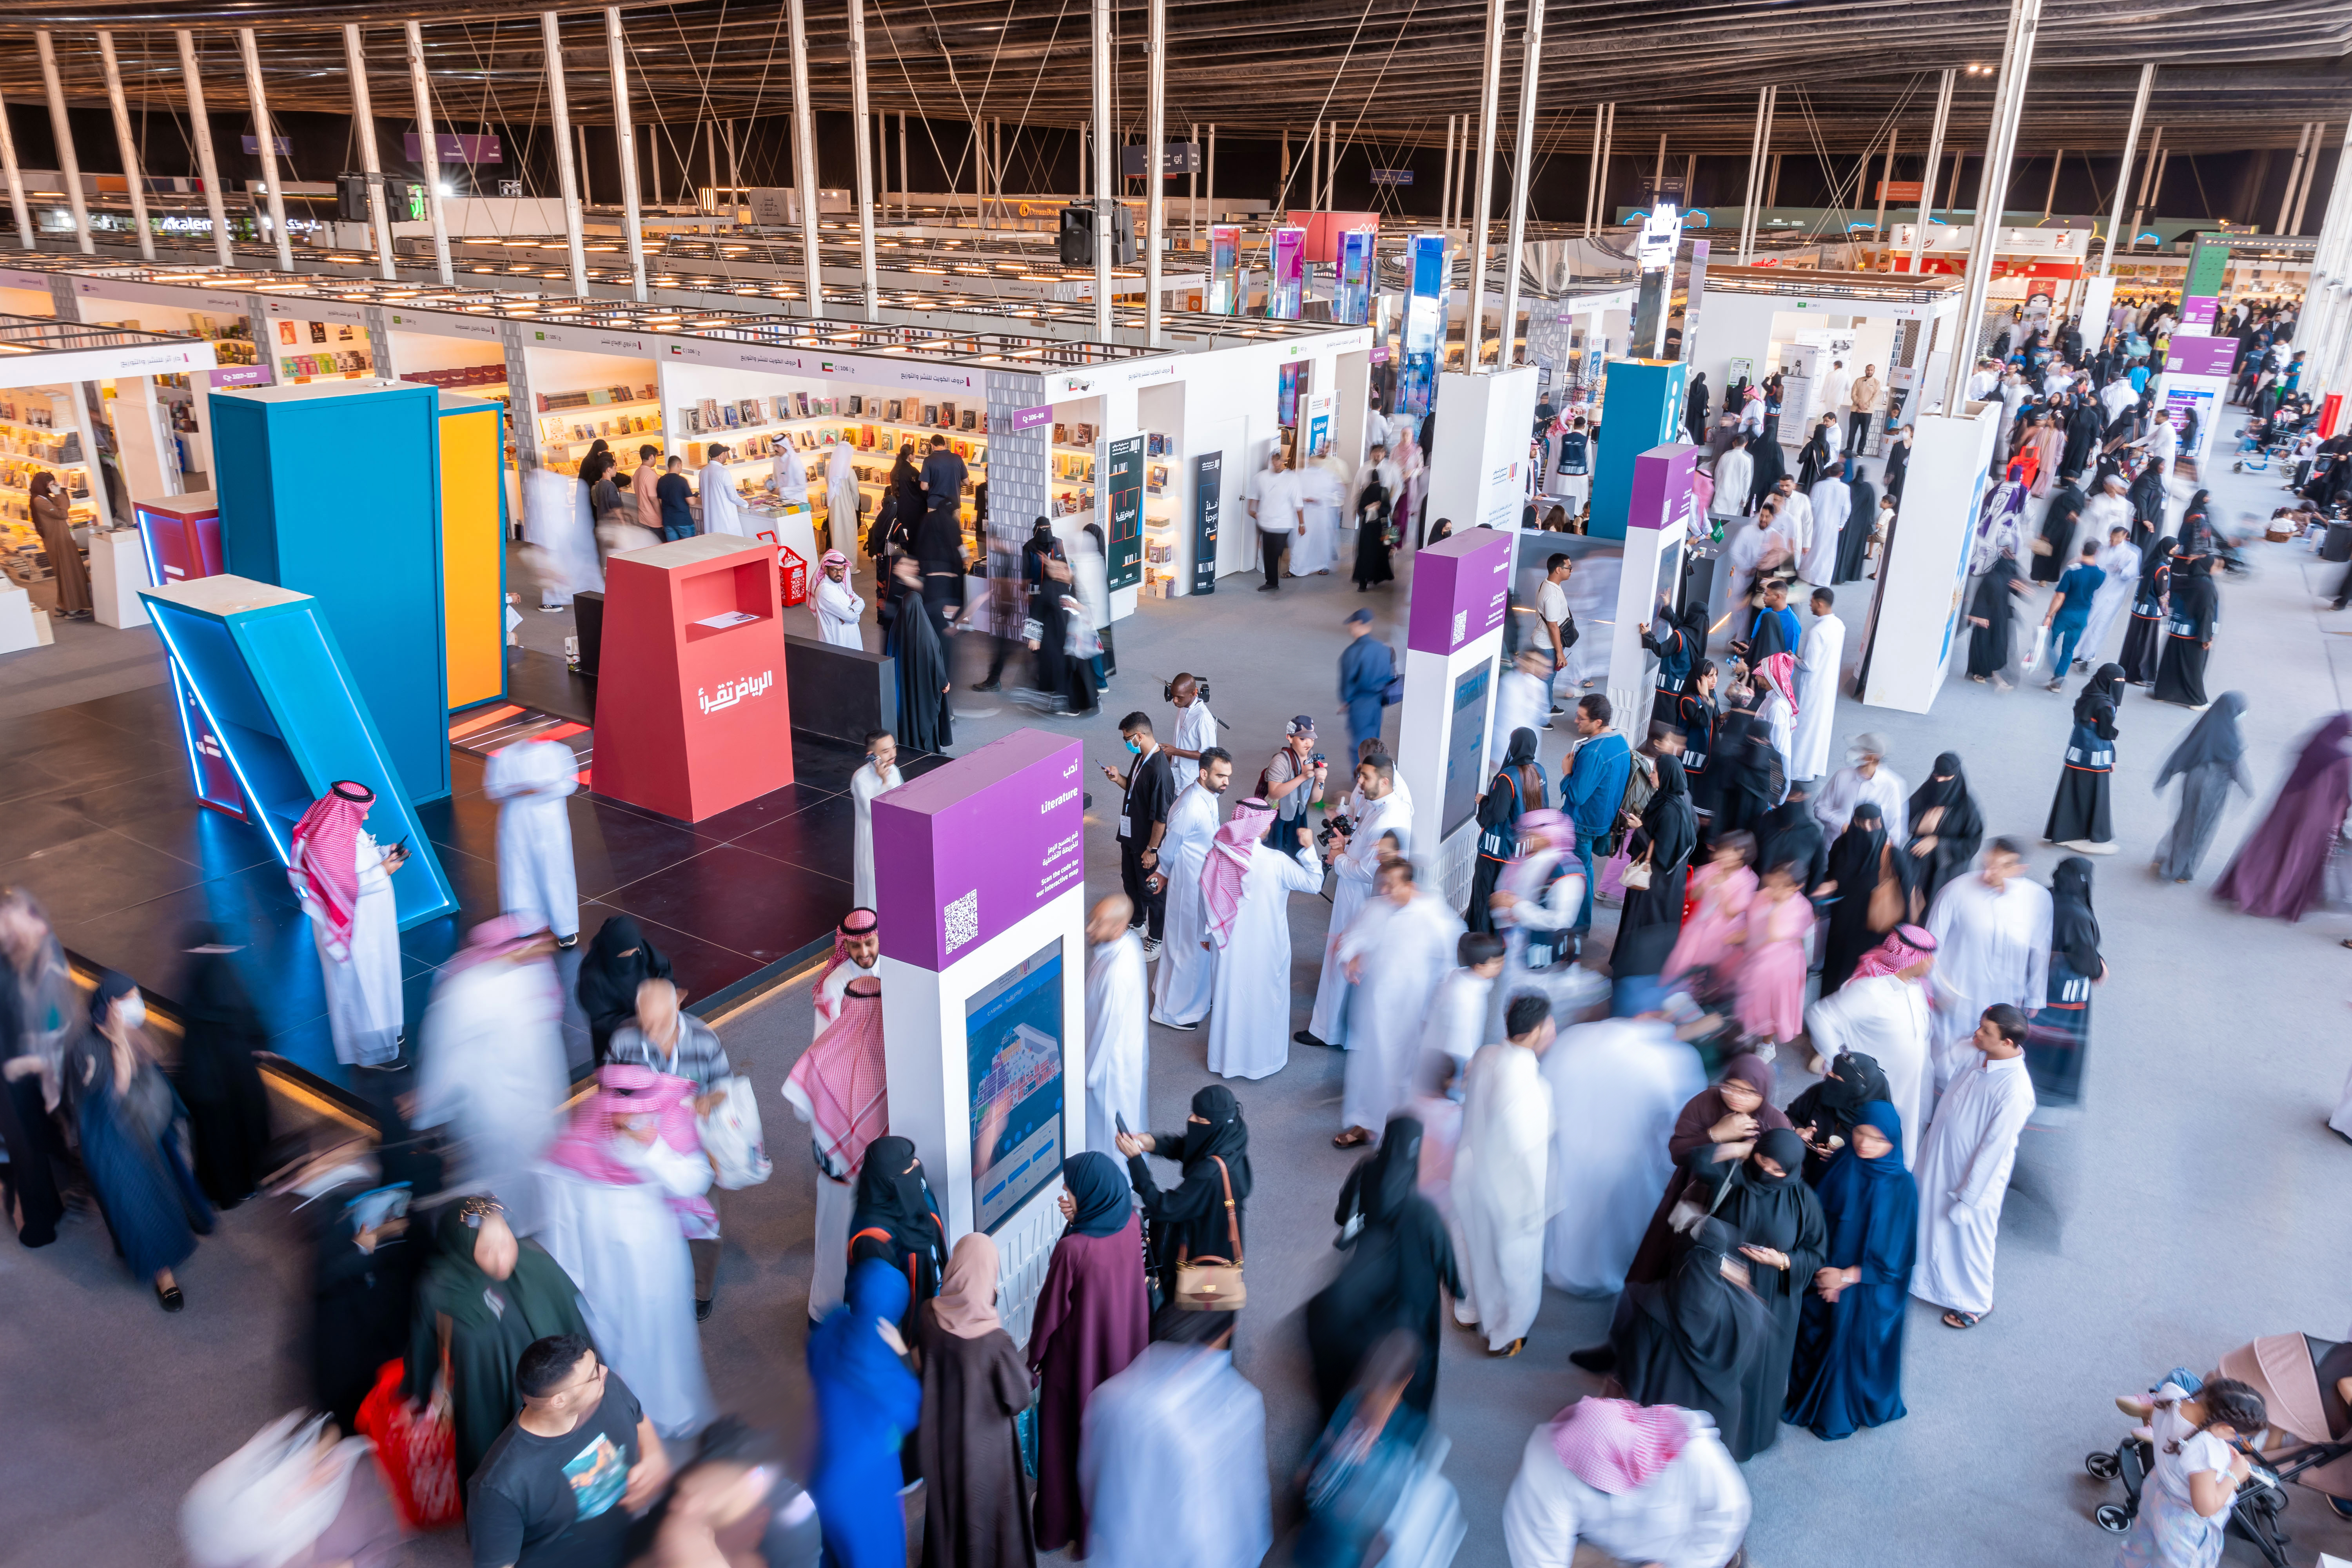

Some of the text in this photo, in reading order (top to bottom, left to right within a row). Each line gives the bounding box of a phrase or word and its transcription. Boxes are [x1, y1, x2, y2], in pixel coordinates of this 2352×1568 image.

[121, 358, 145, 368] والتوزيع
[147, 356, 163, 365] للنشر
[757, 355, 768, 363] للنشر
[920, 373, 932, 381] للنشر
[933, 376, 950, 384] الكويت
[1128, 373, 1141, 381] والتوزيع
[1563, 374, 1607, 387] Deser
[1493, 561, 1508, 573] Literature
[1489, 616, 1499, 624] interactive
[698, 670, 773, 715] الرياض تقرأ
[1063, 758, 1078, 779] أدب
[1041, 787, 1078, 815] Literature
[1047, 830, 1078, 855] قم بمسح الرمز
[1042, 840, 1078, 866] للخريطة التفاعلية
[1041, 873, 1053, 886] Scan
[1061, 864, 1072, 874] code
[1036, 868, 1079, 898] our interactive map
[987, 1003, 1003, 1016] CASHIN
